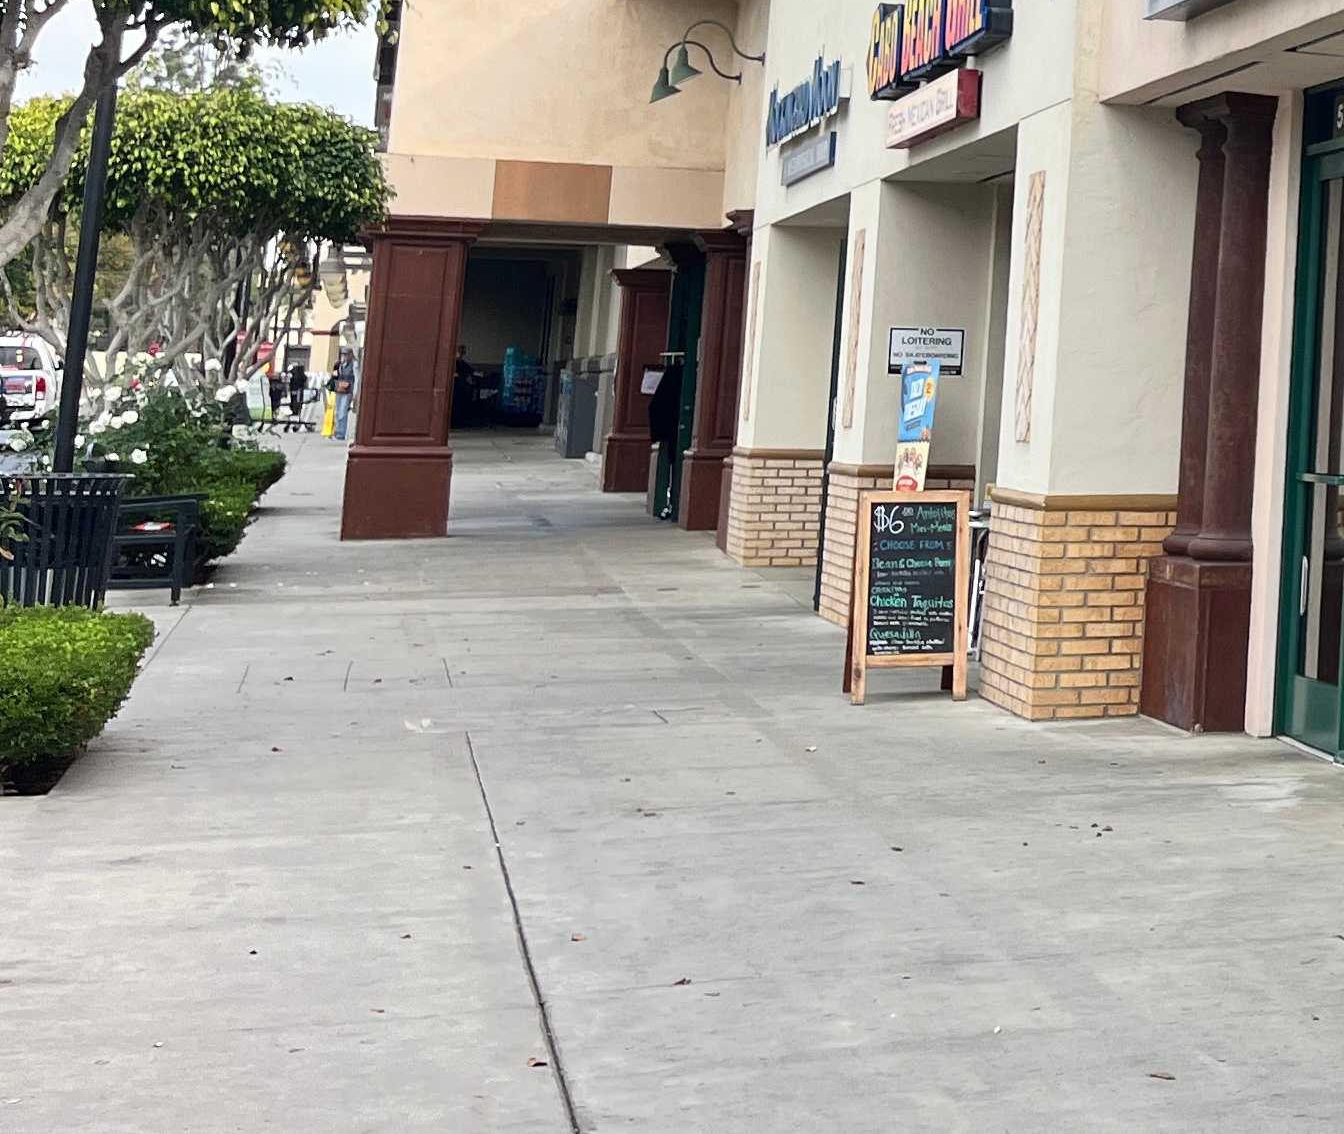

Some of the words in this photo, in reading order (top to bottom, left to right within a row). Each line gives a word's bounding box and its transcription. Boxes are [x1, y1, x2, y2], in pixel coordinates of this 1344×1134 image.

[920, 328, 935, 336] NO
[901, 337, 952, 345] LOITERING
[873, 505, 905, 534] $6
[880, 540, 914, 551] CHOOSE
[919, 540, 944, 550] FROM
[870, 595, 907, 607] Chicken
